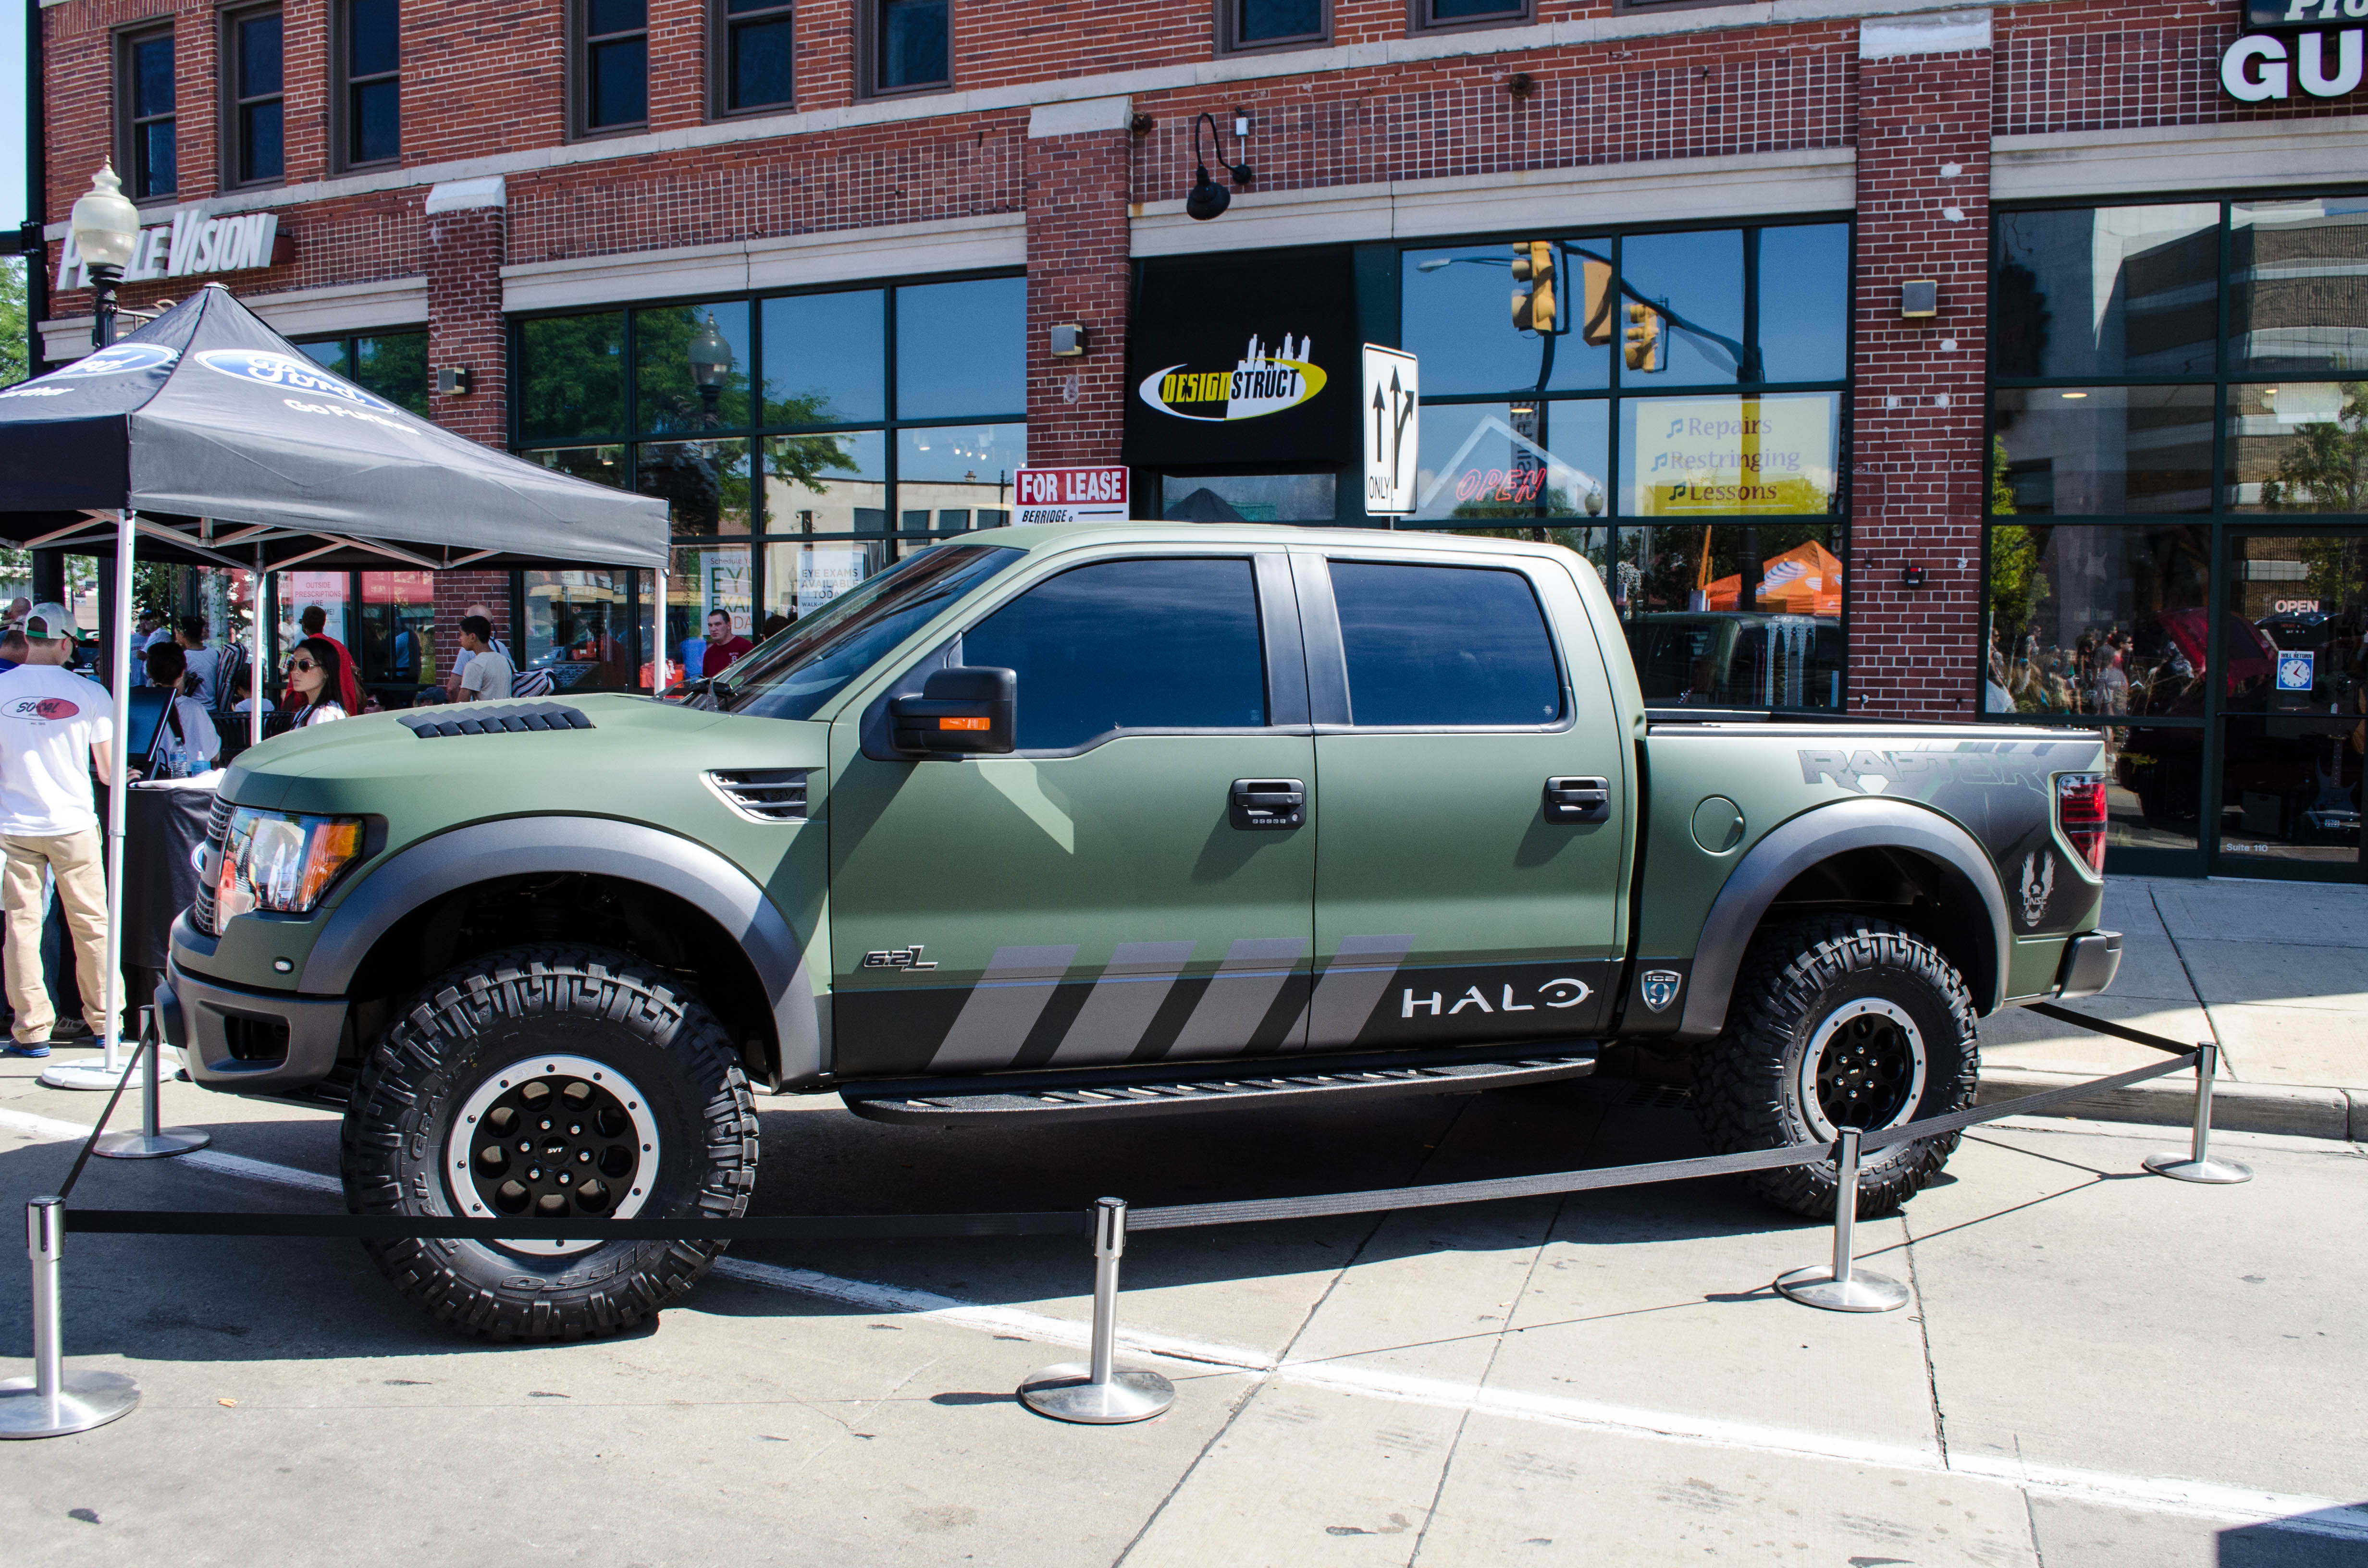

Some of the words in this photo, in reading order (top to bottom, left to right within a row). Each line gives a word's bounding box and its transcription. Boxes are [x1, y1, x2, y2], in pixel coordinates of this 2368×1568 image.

[2221, 29, 2363, 101] GU
[247, 355, 366, 404] Ford
[283, 399, 330, 415] Go
[1688, 416, 1772, 440] Repairs
[1671, 449, 1801, 472] Restringing
[1022, 473, 1058, 502] FOR
[1066, 471, 1122, 501] LEASE
[1369, 475, 1390, 500] ONLY
[1455, 468, 1547, 503] OPEN
[1690, 481, 1777, 501] Lessons
[1022, 510, 1067, 524] BERRIDGE
[802, 569, 820, 577] EYE
[824, 569, 858, 577] EXAMS
[2275, 600, 2319, 613] OPEN
[1797, 750, 2048, 798] RAPTOR
[2226, 843, 2249, 851] Suite
[1401, 978, 1594, 1018] HALO
[1649, 982, 1670, 1004] 9
